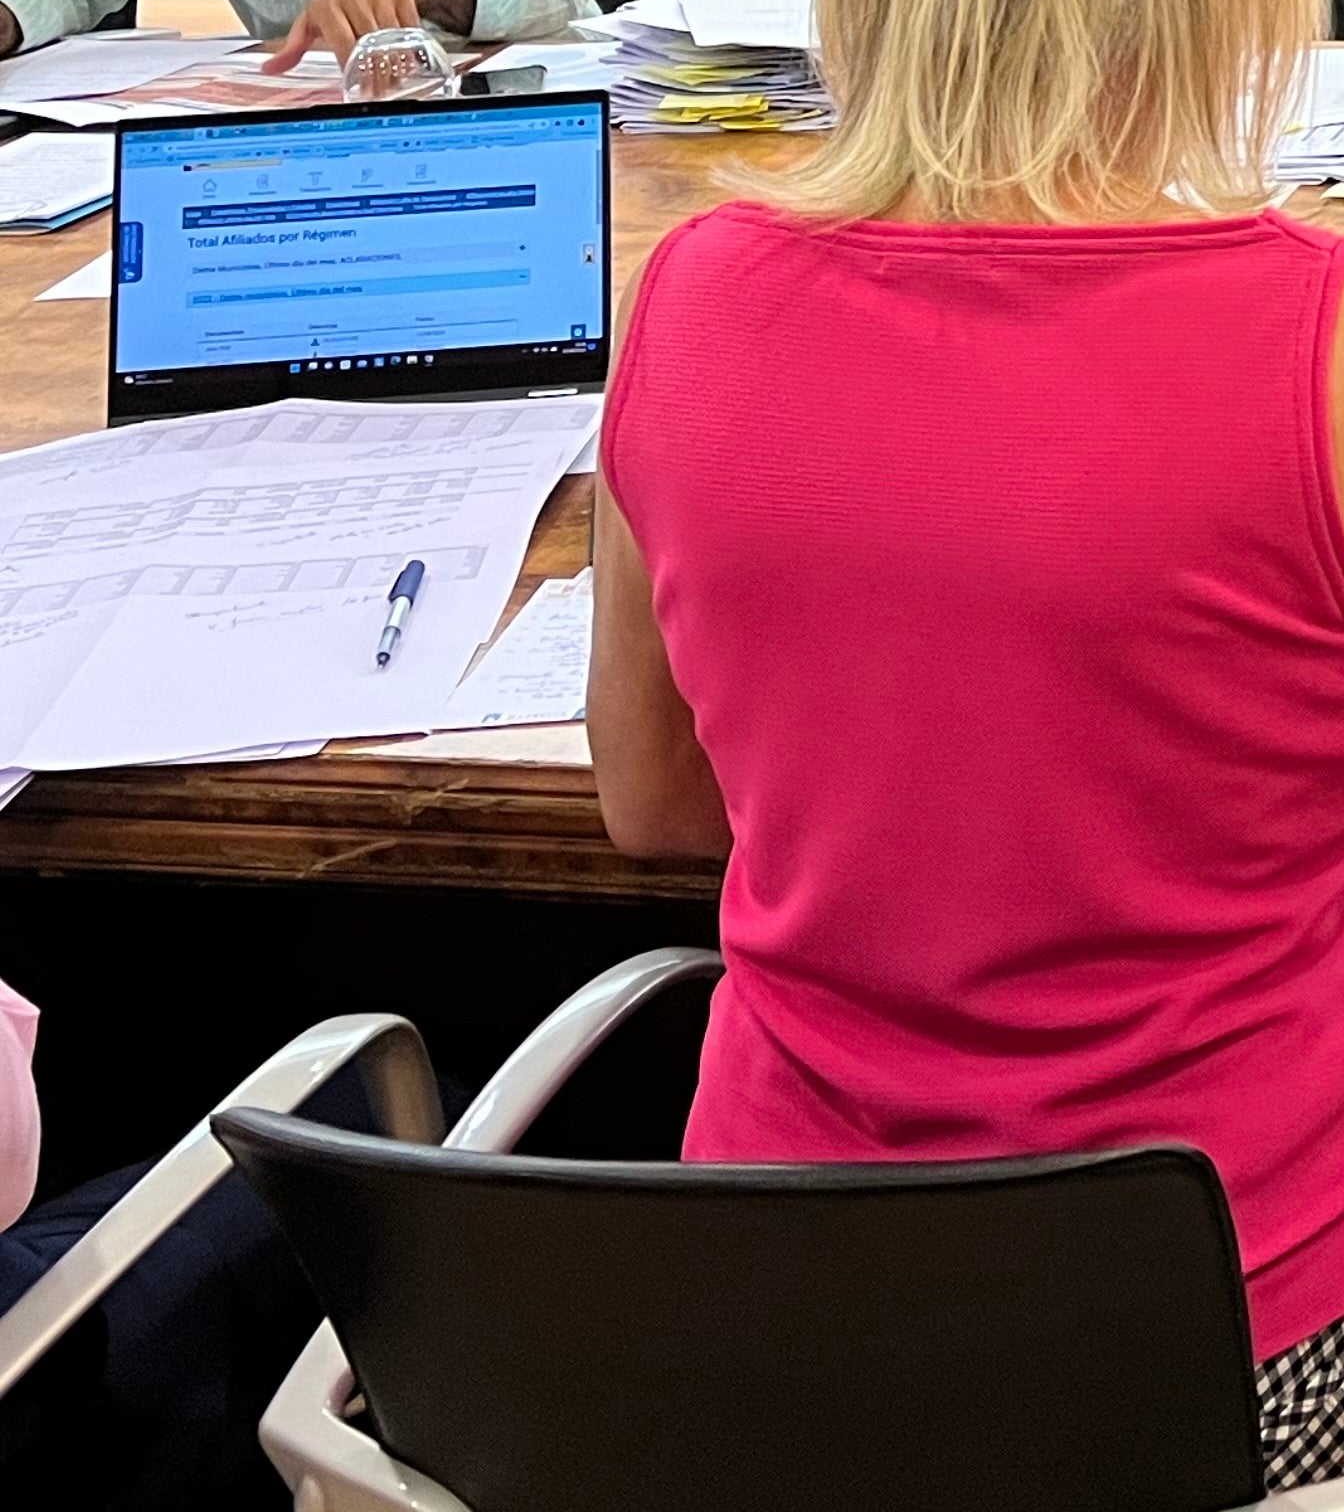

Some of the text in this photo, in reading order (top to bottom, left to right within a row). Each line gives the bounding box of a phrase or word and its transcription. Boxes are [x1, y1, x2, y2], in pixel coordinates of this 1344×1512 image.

[188, 228, 357, 249] Total Afiliados por Régimen
